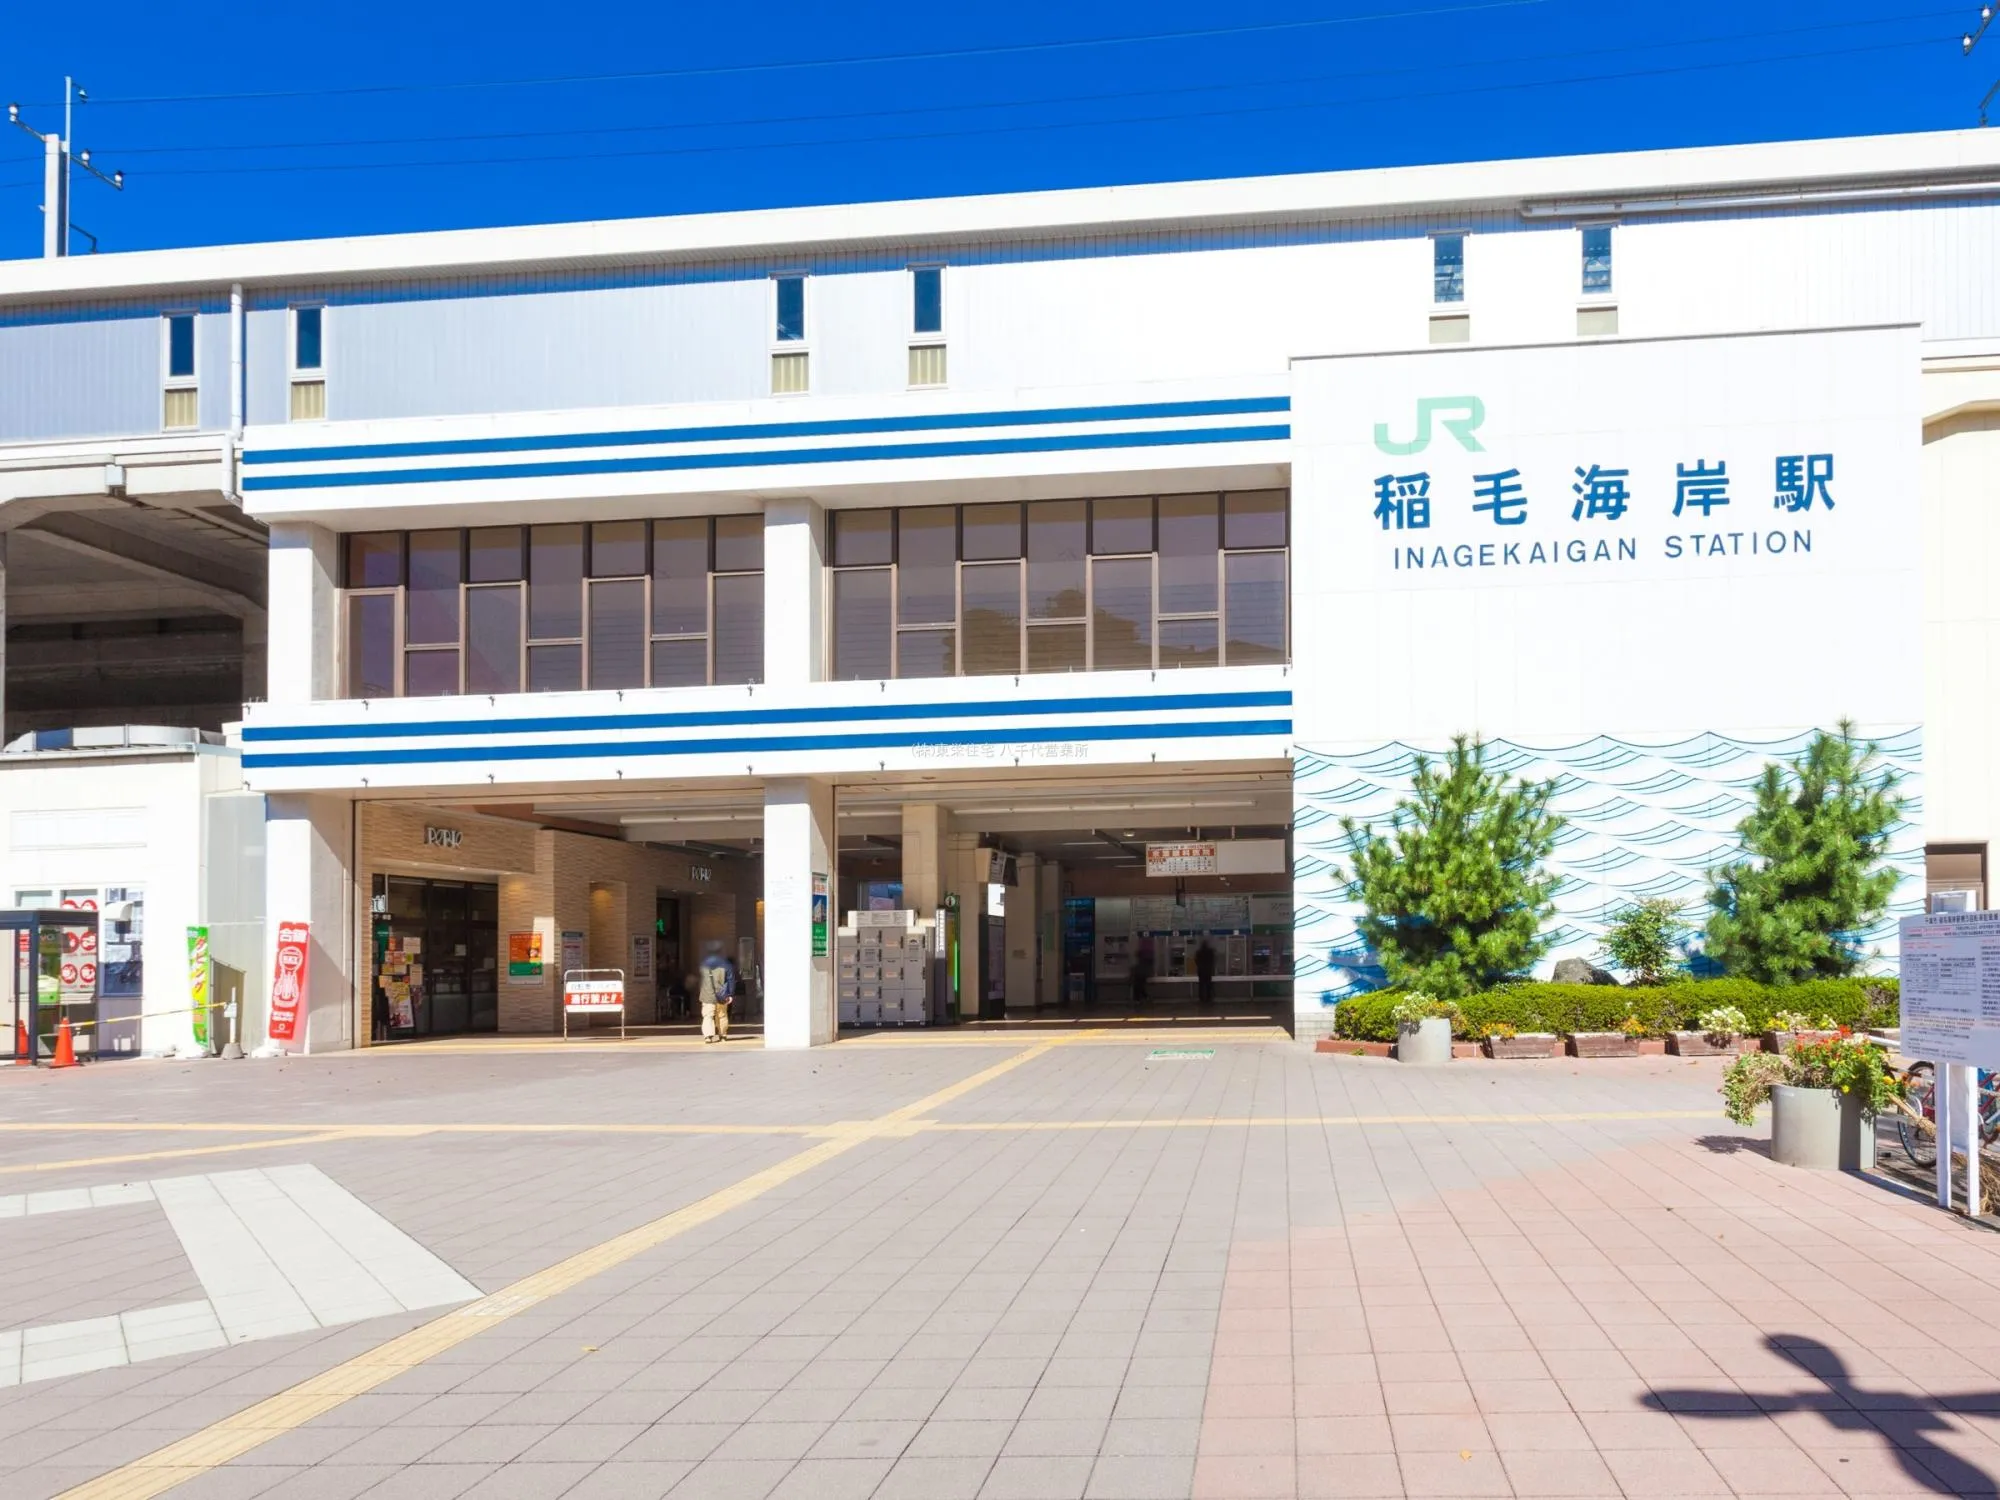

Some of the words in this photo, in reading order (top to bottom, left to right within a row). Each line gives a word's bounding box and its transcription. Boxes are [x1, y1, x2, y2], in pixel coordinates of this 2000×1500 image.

[1374, 396, 1488, 456] JR
[1373, 453, 1836, 530] 稲毛海岸駅
[1393, 537, 1638, 570] INAGEKAIGAN
[1665, 530, 1813, 558] STATION
